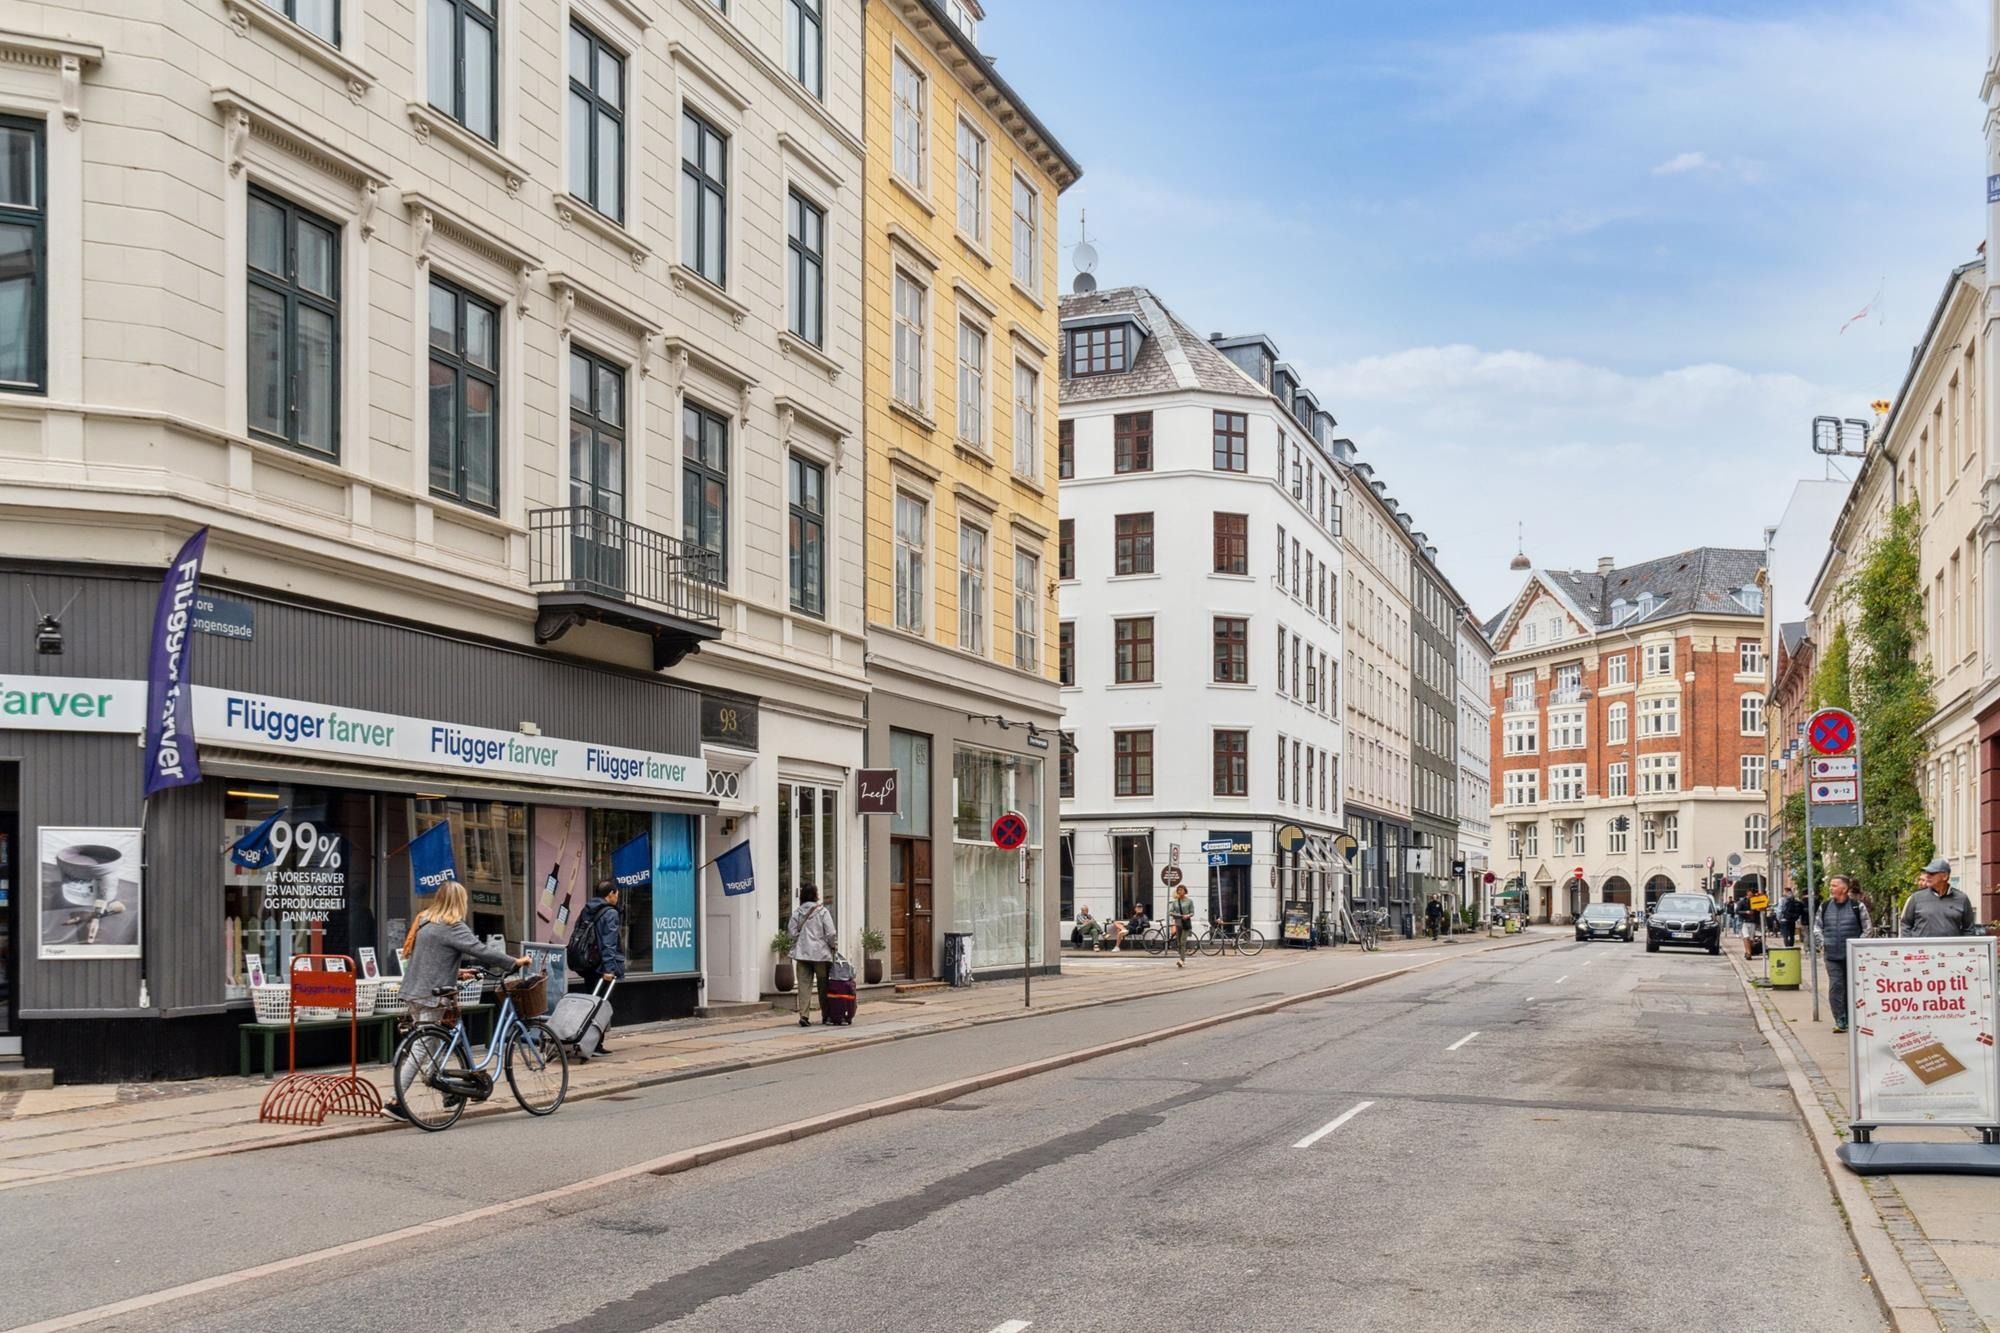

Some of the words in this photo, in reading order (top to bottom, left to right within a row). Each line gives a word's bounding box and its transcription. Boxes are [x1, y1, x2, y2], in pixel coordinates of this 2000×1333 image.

[227, 697, 325, 742] Flügger
[328, 712, 395, 747] farver
[720, 708, 737, 732] 93
[431, 727, 506, 764] Flügger
[508, 737, 558, 767] farver
[586, 748, 644, 780] Flügger
[646, 757, 686, 782] farver
[269, 820, 342, 868] 99%
[265, 871, 278, 882] AF
[280, 872, 310, 883] VORES
[311, 872, 345, 883] FARVER
[266, 885, 278, 896] ER
[280, 885, 344, 896] VANDBASERET
[264, 898, 280, 909] OG
[281, 898, 341, 909] PRODUCERET
[282, 911, 330, 922] DANMARK
[655, 917, 677, 929] VÆLG
[678, 917, 692, 929] DIN
[655, 931, 692, 948] FARVE
[1875, 977, 1922, 993] Skrab
[1927, 980, 1946, 995] op
[1950, 975, 1968, 991] til
[1881, 997, 1918, 1012] 50%
[1922, 996, 1966, 1011] rabat
